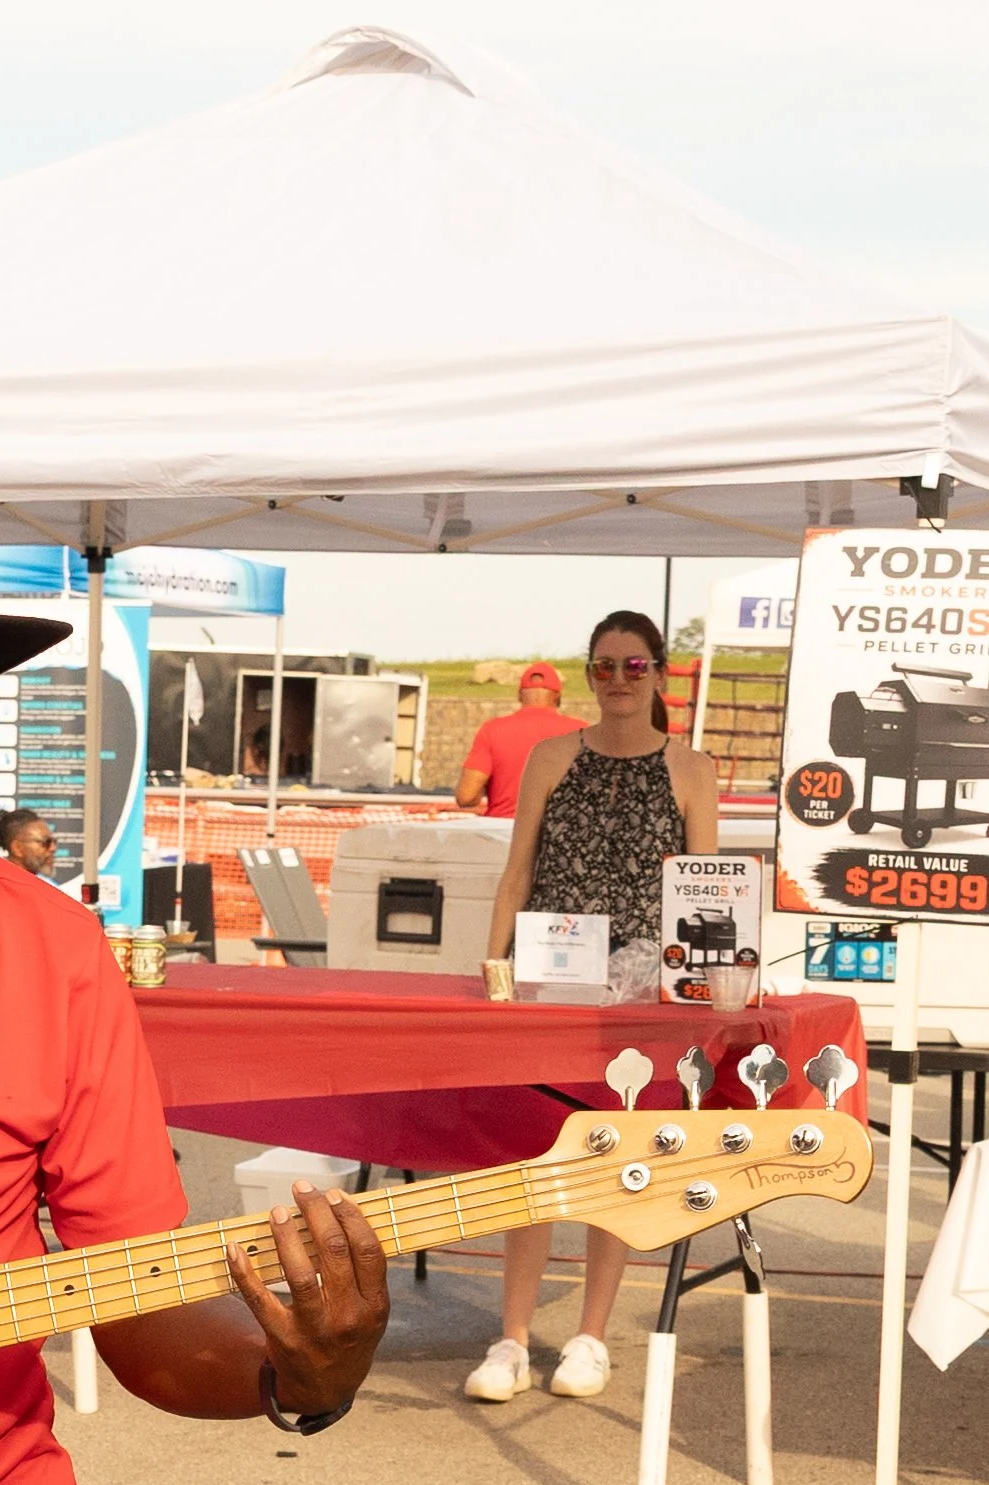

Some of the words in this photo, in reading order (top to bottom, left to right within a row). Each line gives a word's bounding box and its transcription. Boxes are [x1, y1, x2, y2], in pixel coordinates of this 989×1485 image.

[864, 640, 939, 653] PELLET
[949, 643, 989, 655] GRI
[798, 769, 843, 799] $20
[810, 800, 829, 810] PER
[803, 809, 835, 821] TICKET
[676, 862, 746, 876] YODER
[868, 853, 919, 870] RETAIL
[922, 856, 969, 872] VALUE
[674, 884, 728, 897] YS640S
[845, 866, 988, 911] $2699
[730, 1162, 834, 1190] Thompson
